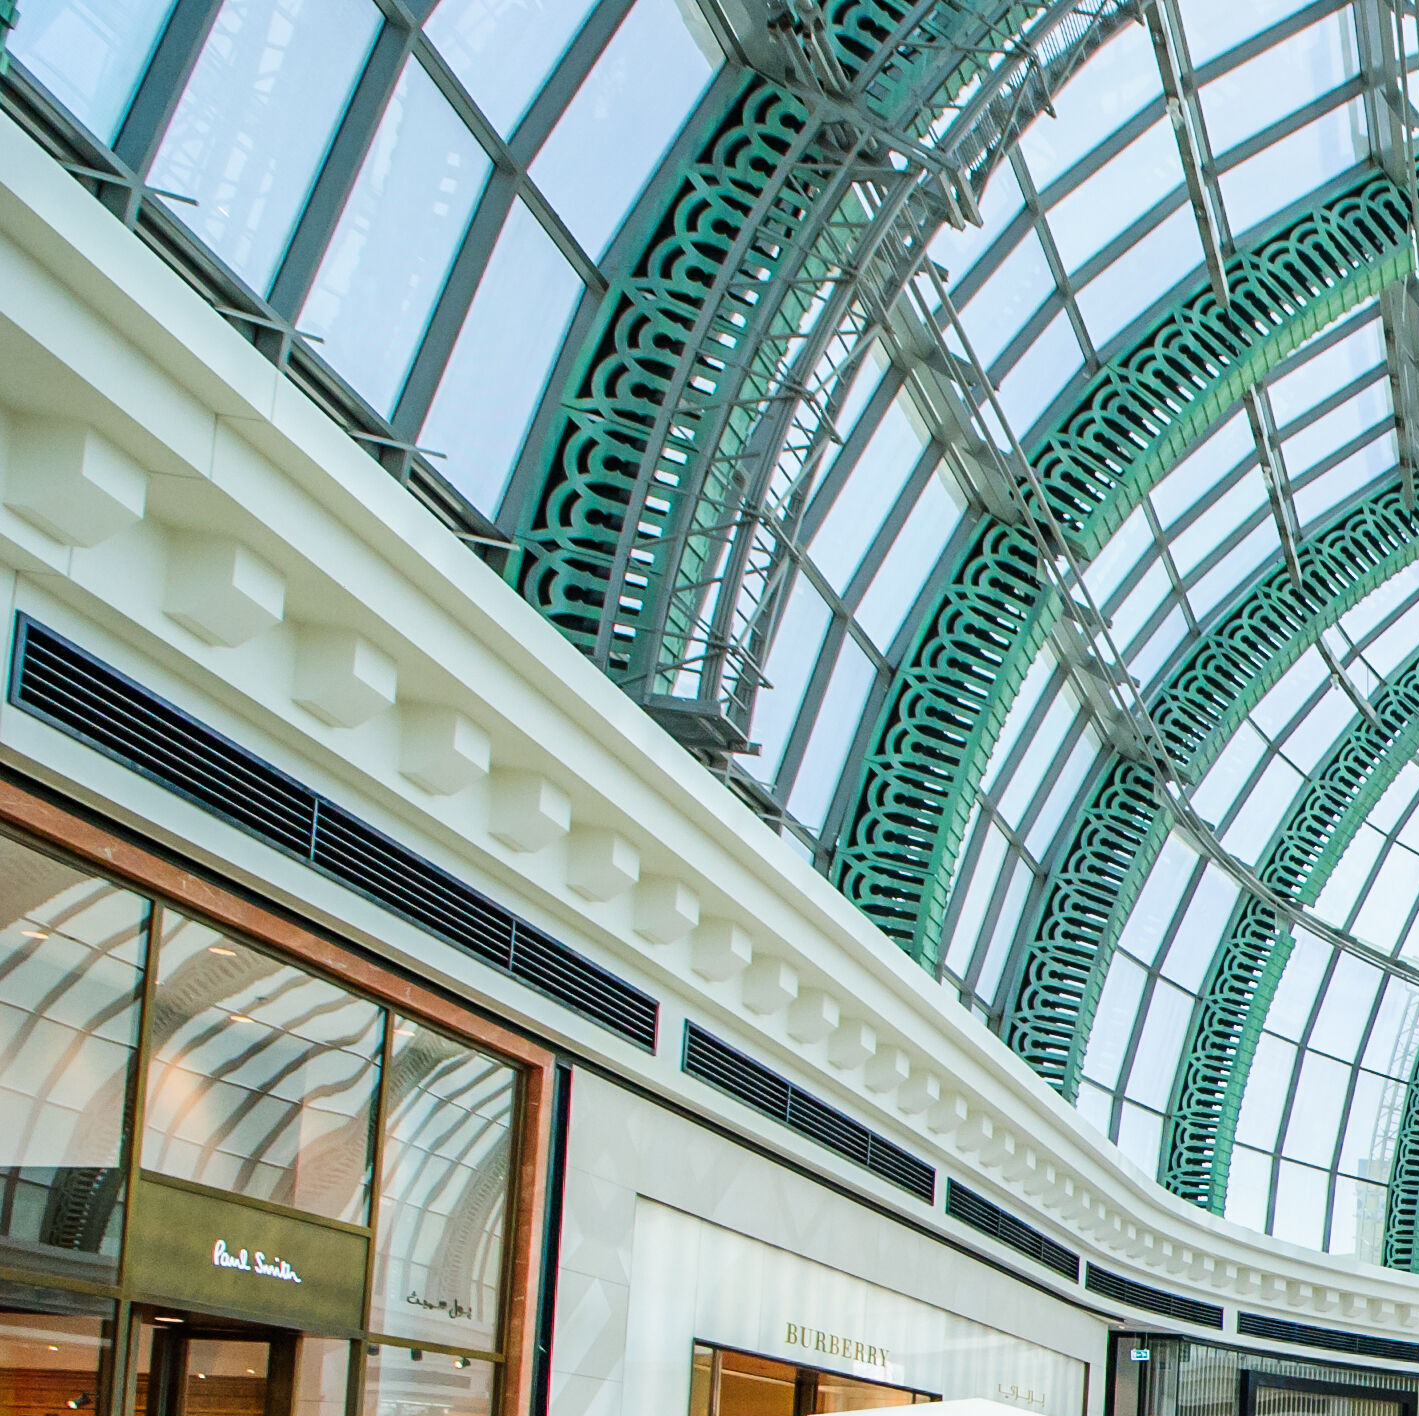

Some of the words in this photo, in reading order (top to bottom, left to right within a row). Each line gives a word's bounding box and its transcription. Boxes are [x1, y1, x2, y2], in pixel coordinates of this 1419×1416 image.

[213, 1240, 251, 1271] Paul
[253, 1251, 302, 1284] Smith
[784, 1322, 891, 1368] BURBERRY
